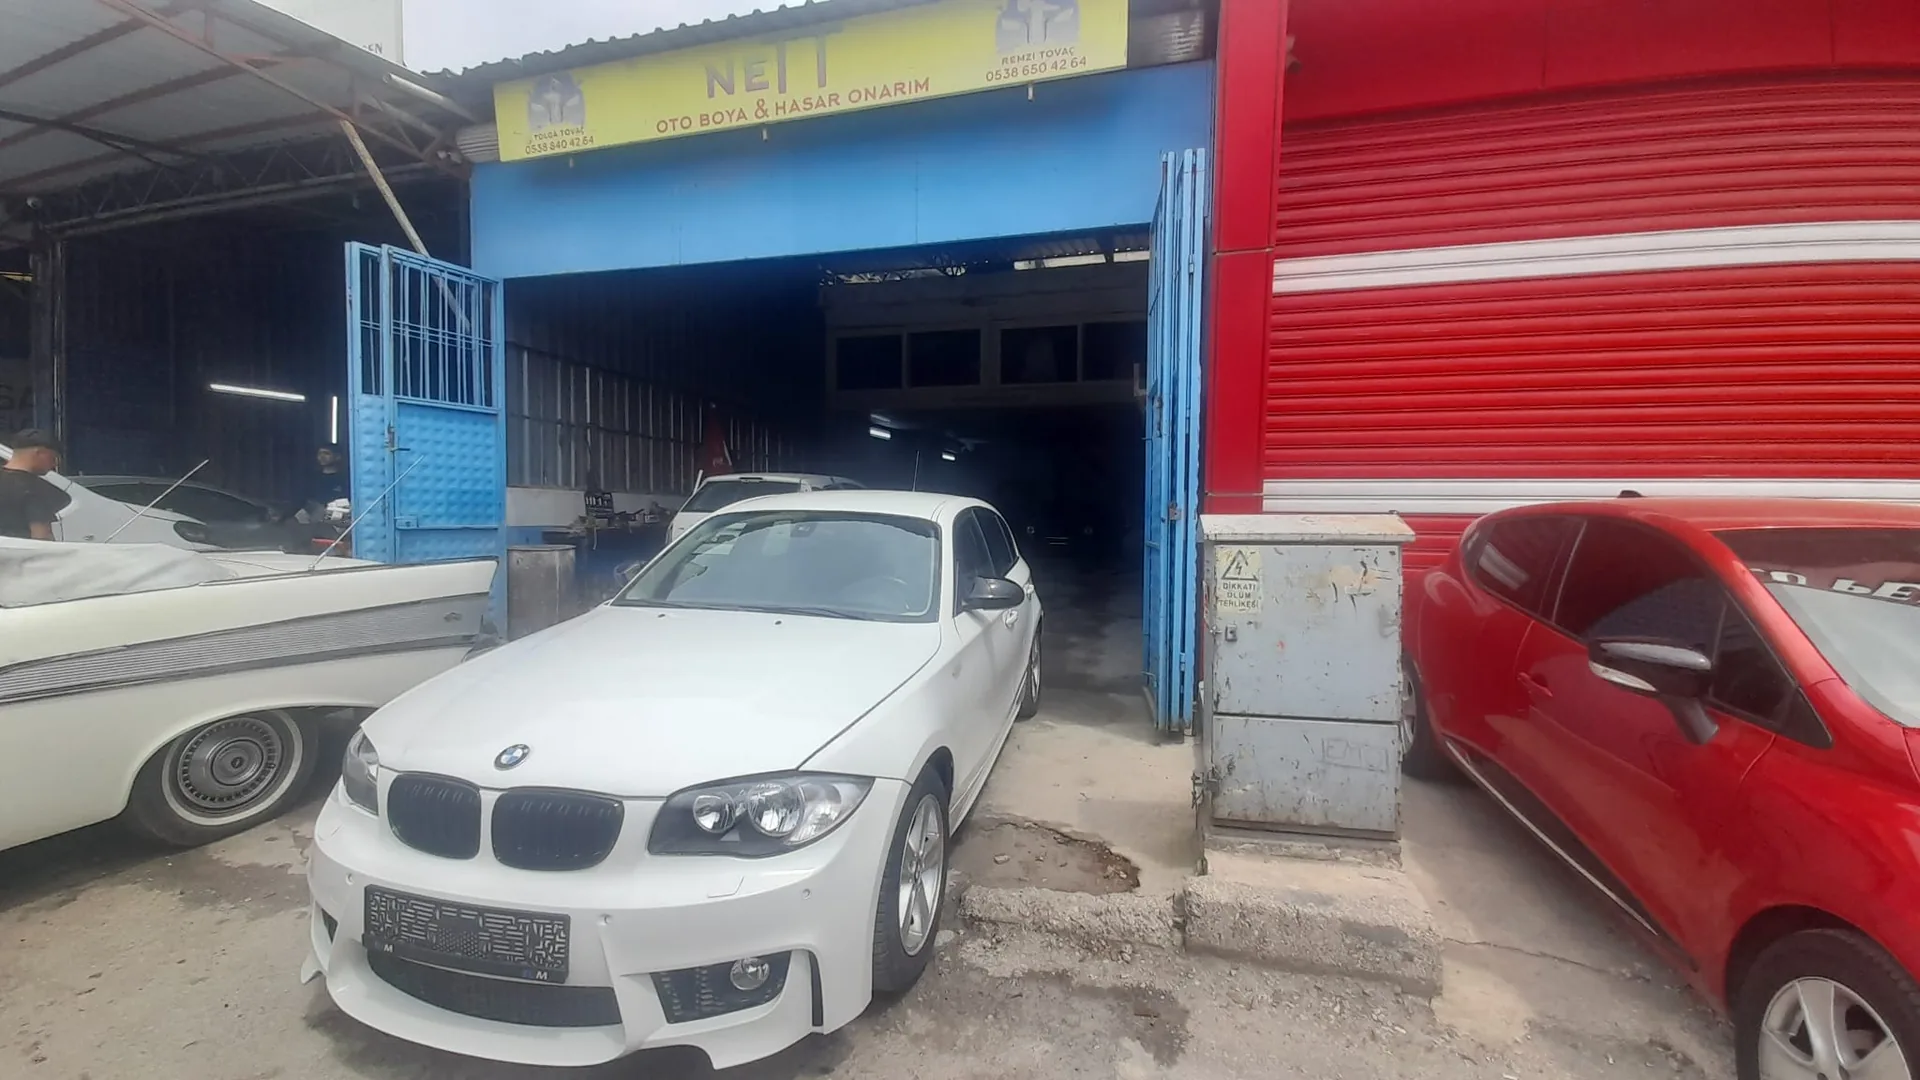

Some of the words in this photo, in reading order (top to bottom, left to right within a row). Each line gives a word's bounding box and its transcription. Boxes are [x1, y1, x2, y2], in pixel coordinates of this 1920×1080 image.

[986, 67, 1018, 82] 0538
[1022, 62, 1047, 76] 650
[1051, 60, 1067, 71] 42
[1071, 56, 1086, 68] 64
[656, 116, 692, 133] OTO
[700, 107, 748, 127] BOYA
[755, 98, 769, 119] &
[775, 92, 840, 116] HASAR
[848, 77, 930, 103] ONARIM
[536, 970, 548, 980] M
